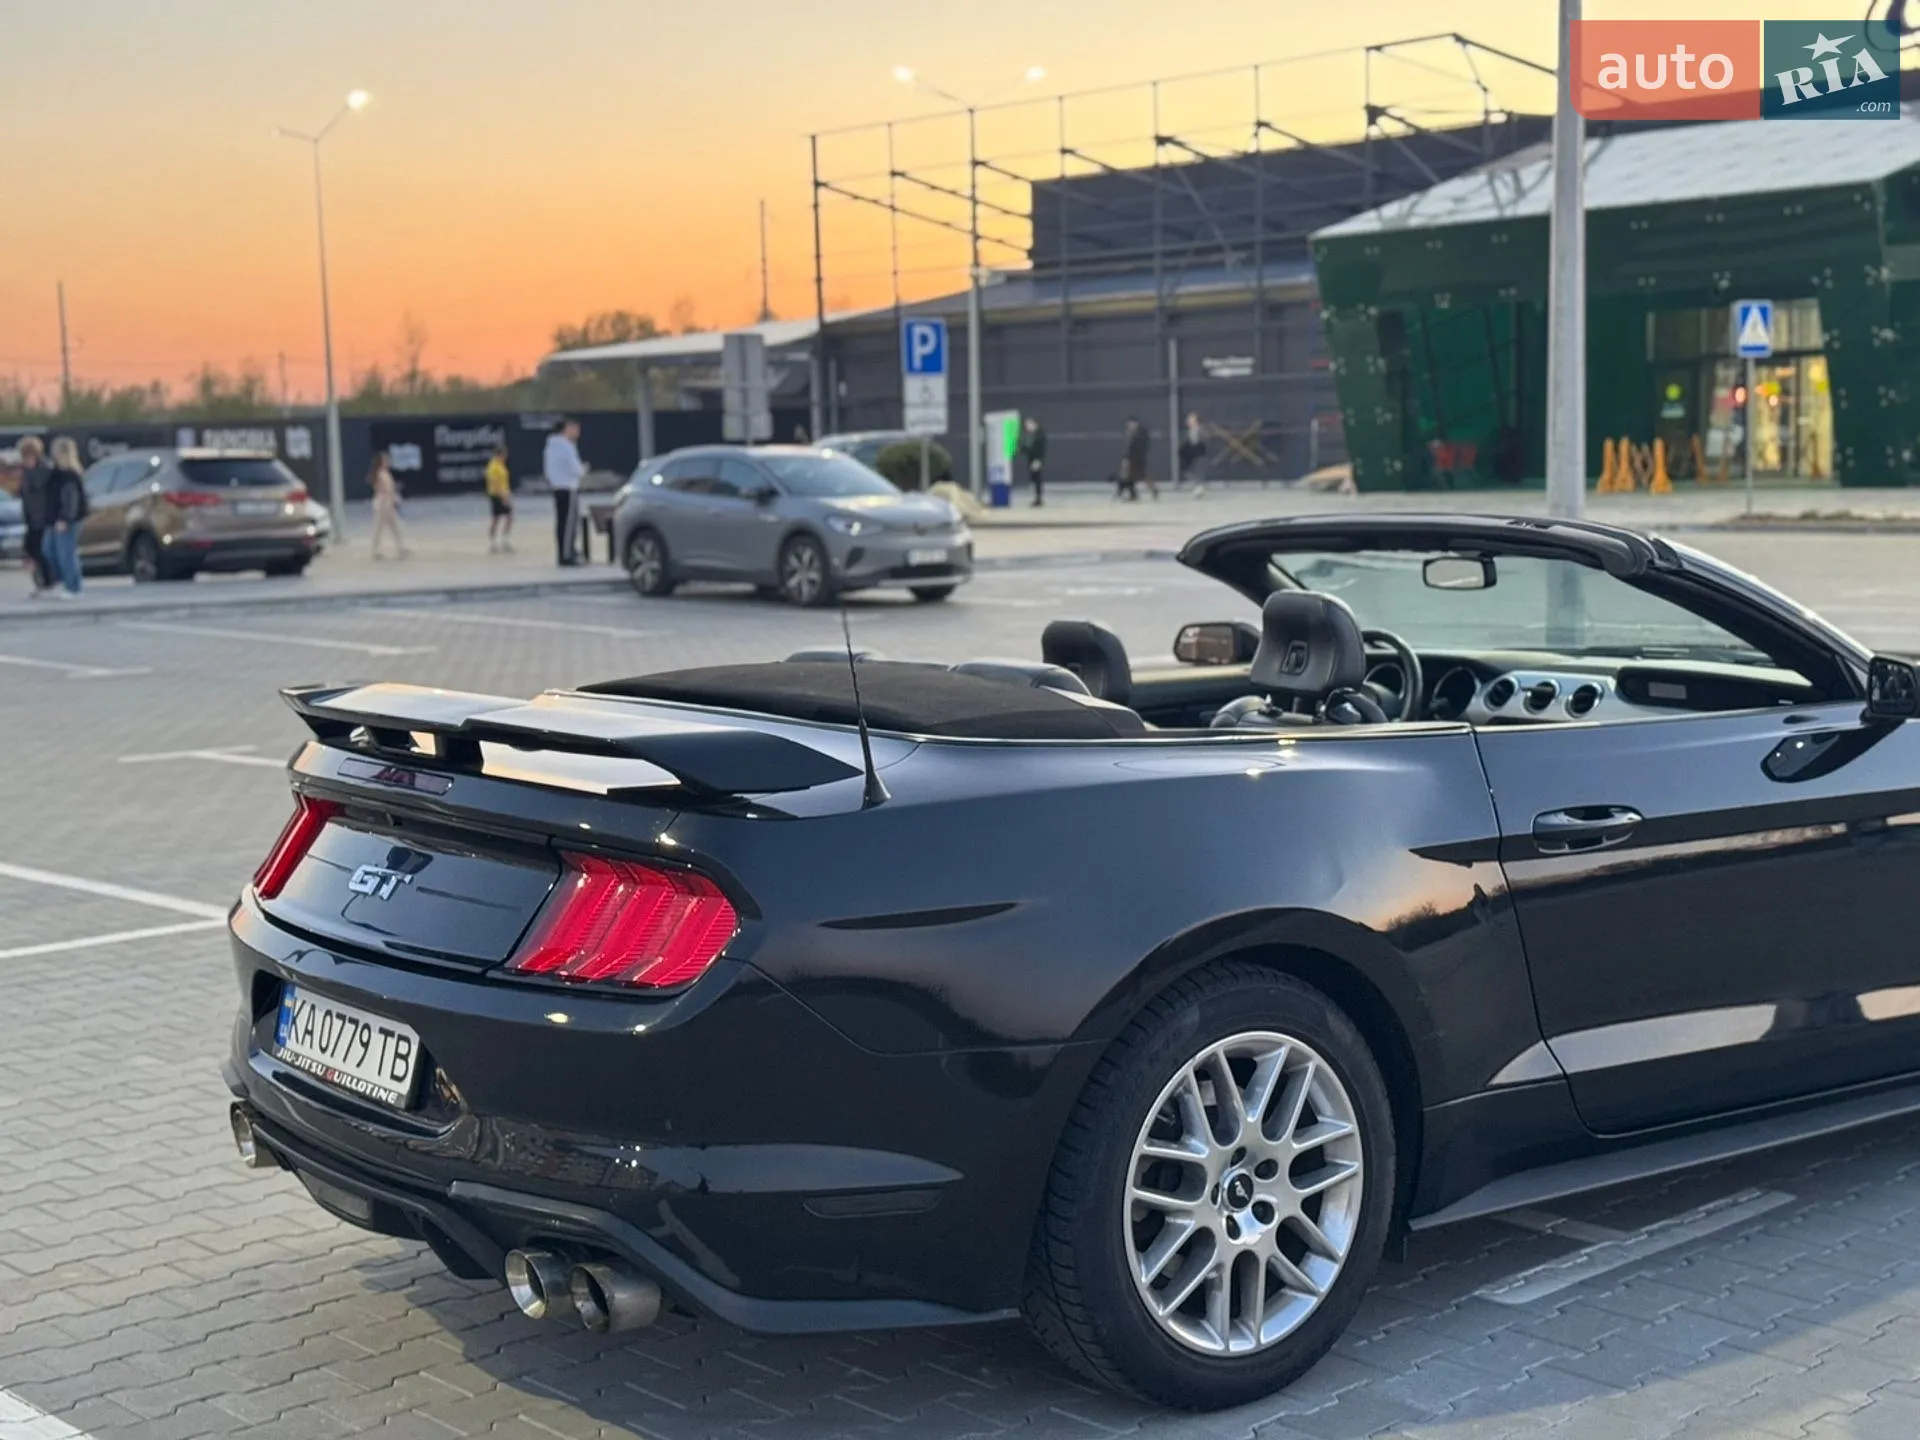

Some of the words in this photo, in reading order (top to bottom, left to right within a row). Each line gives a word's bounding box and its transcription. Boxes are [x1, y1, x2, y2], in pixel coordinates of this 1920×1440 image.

[911, 323, 938, 371] P
[348, 864, 413, 900] GT
[276, 1047, 326, 1077] JIU-JITSU
[325, 1068, 398, 1105] GUILLOTINE
